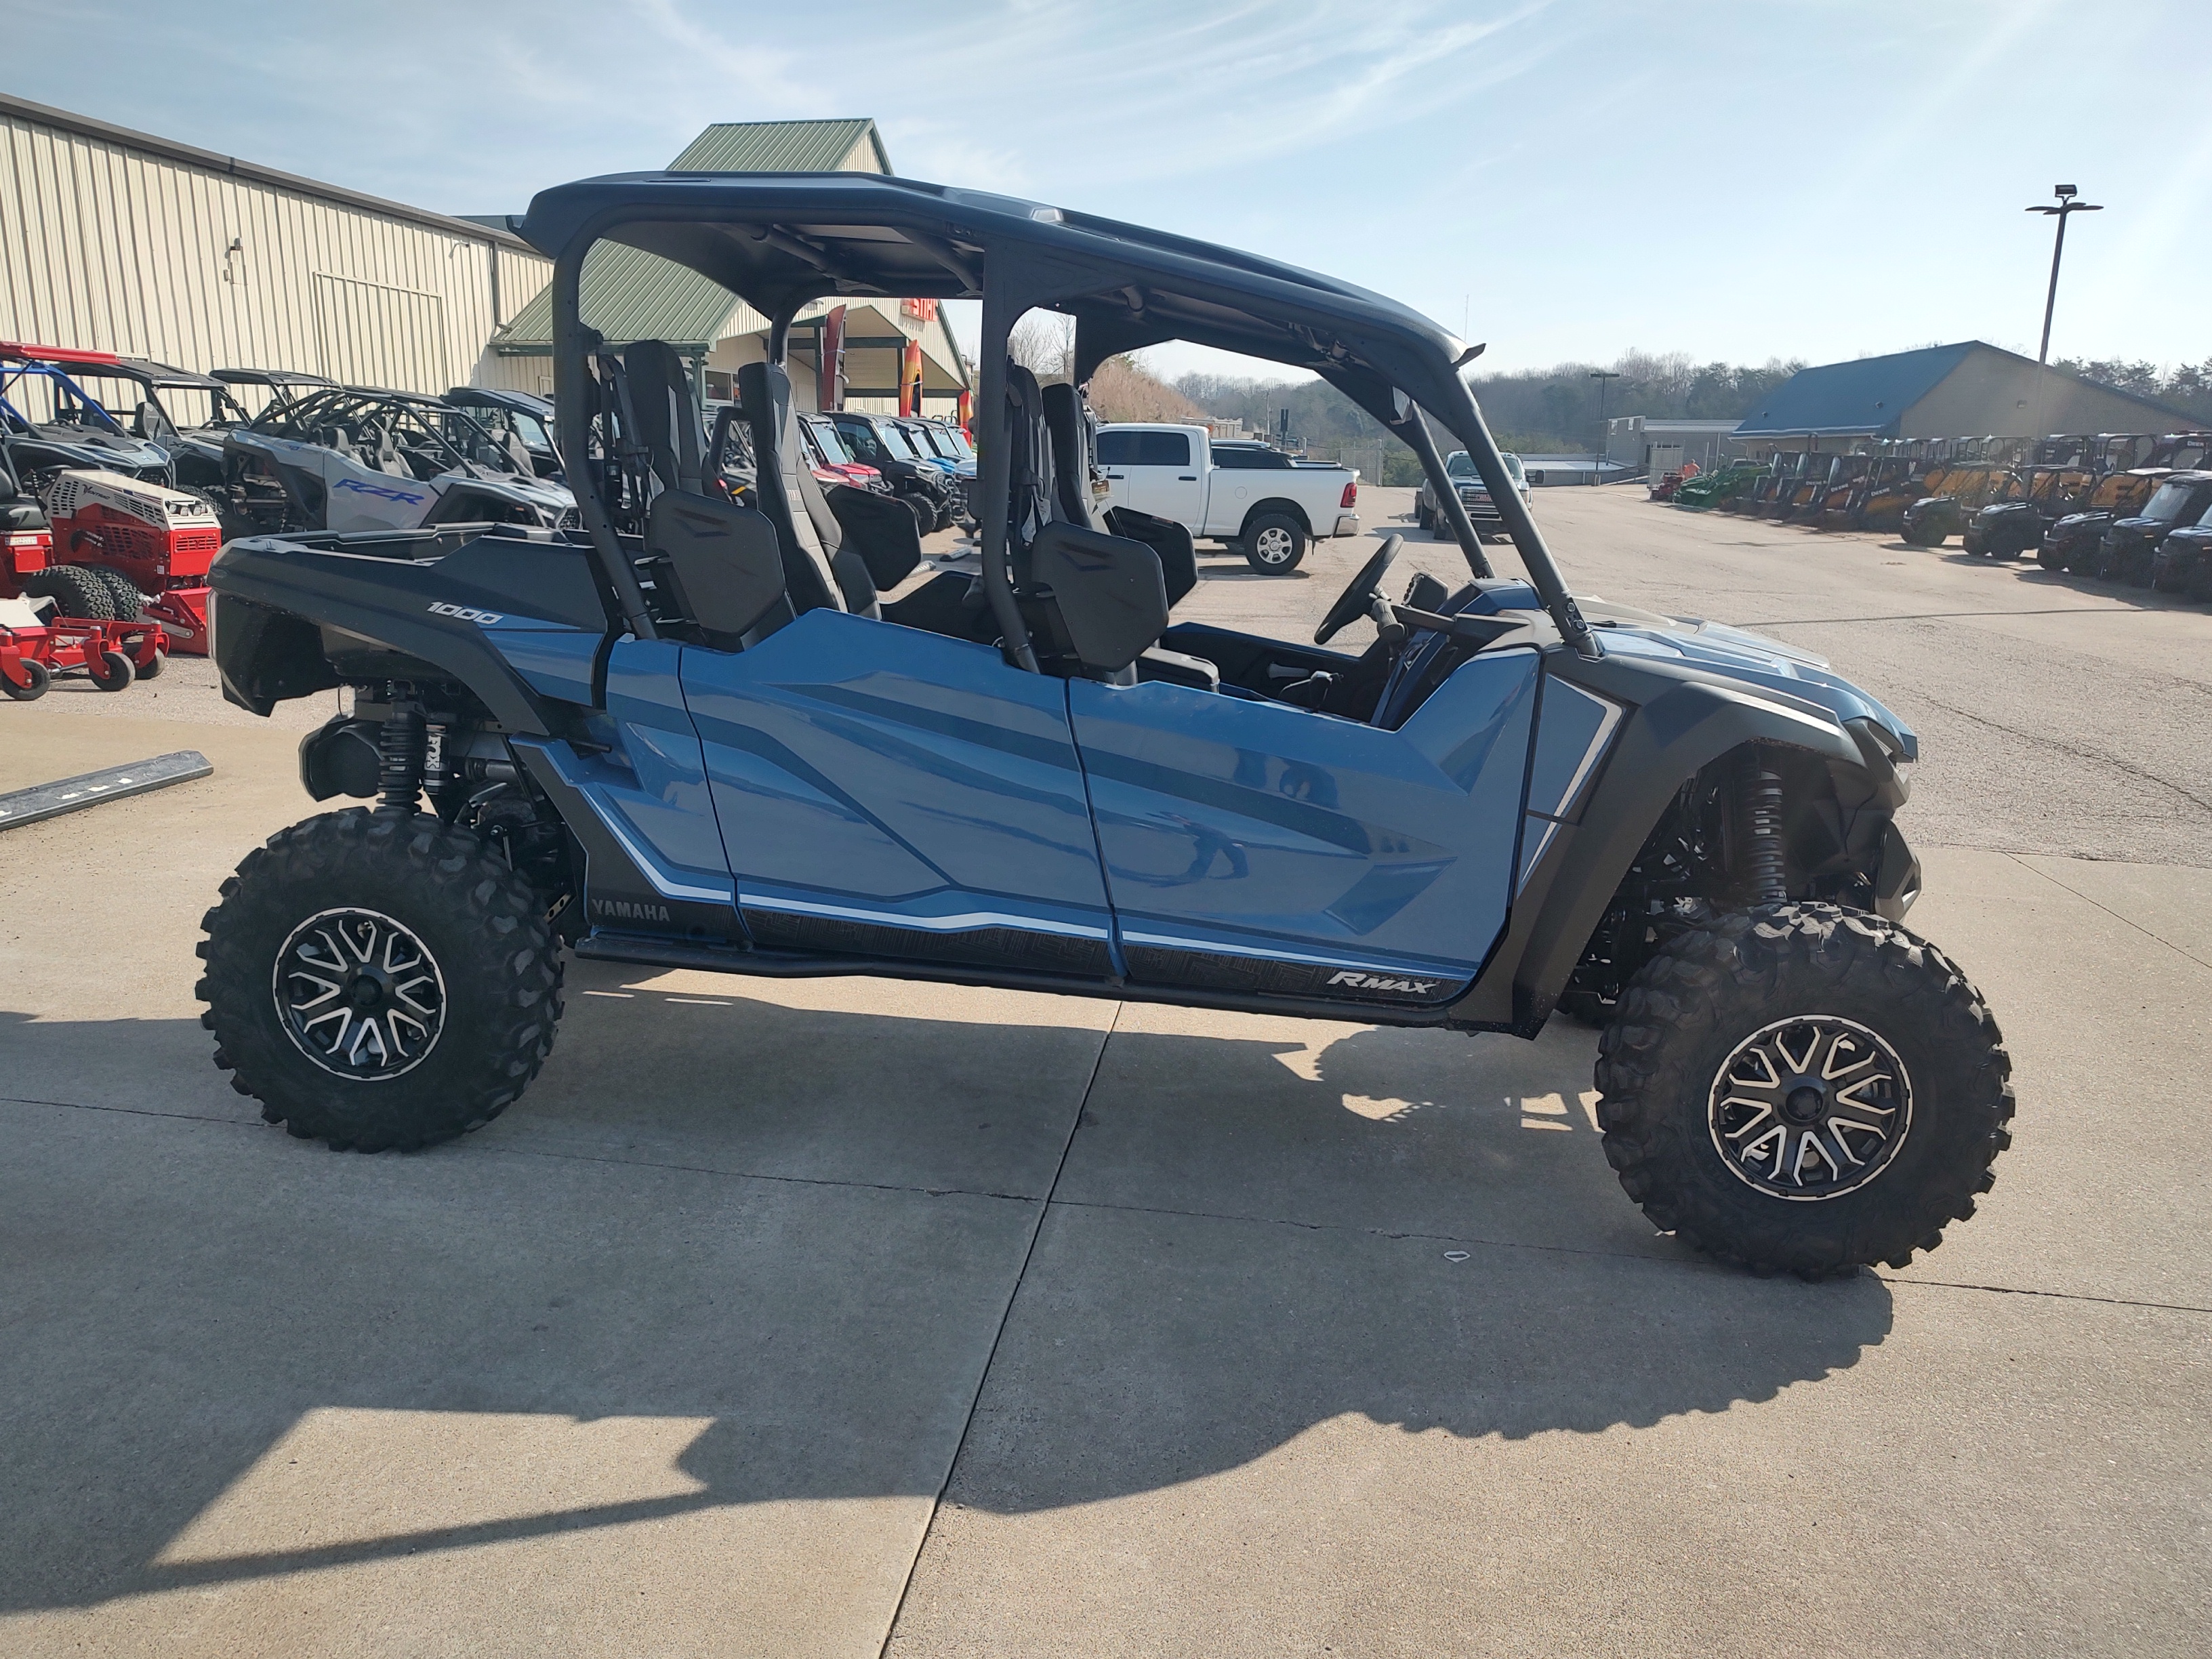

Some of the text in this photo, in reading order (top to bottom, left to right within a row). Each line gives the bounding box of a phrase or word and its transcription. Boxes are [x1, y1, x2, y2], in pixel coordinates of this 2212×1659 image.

[913, 298, 938, 322] STIHL
[333, 478, 425, 506] RZR
[427, 601, 504, 624] 1000
[426, 735, 442, 769] FOX
[591, 899, 670, 922] YAMAHA
[1326, 971, 1437, 994] RMAX
